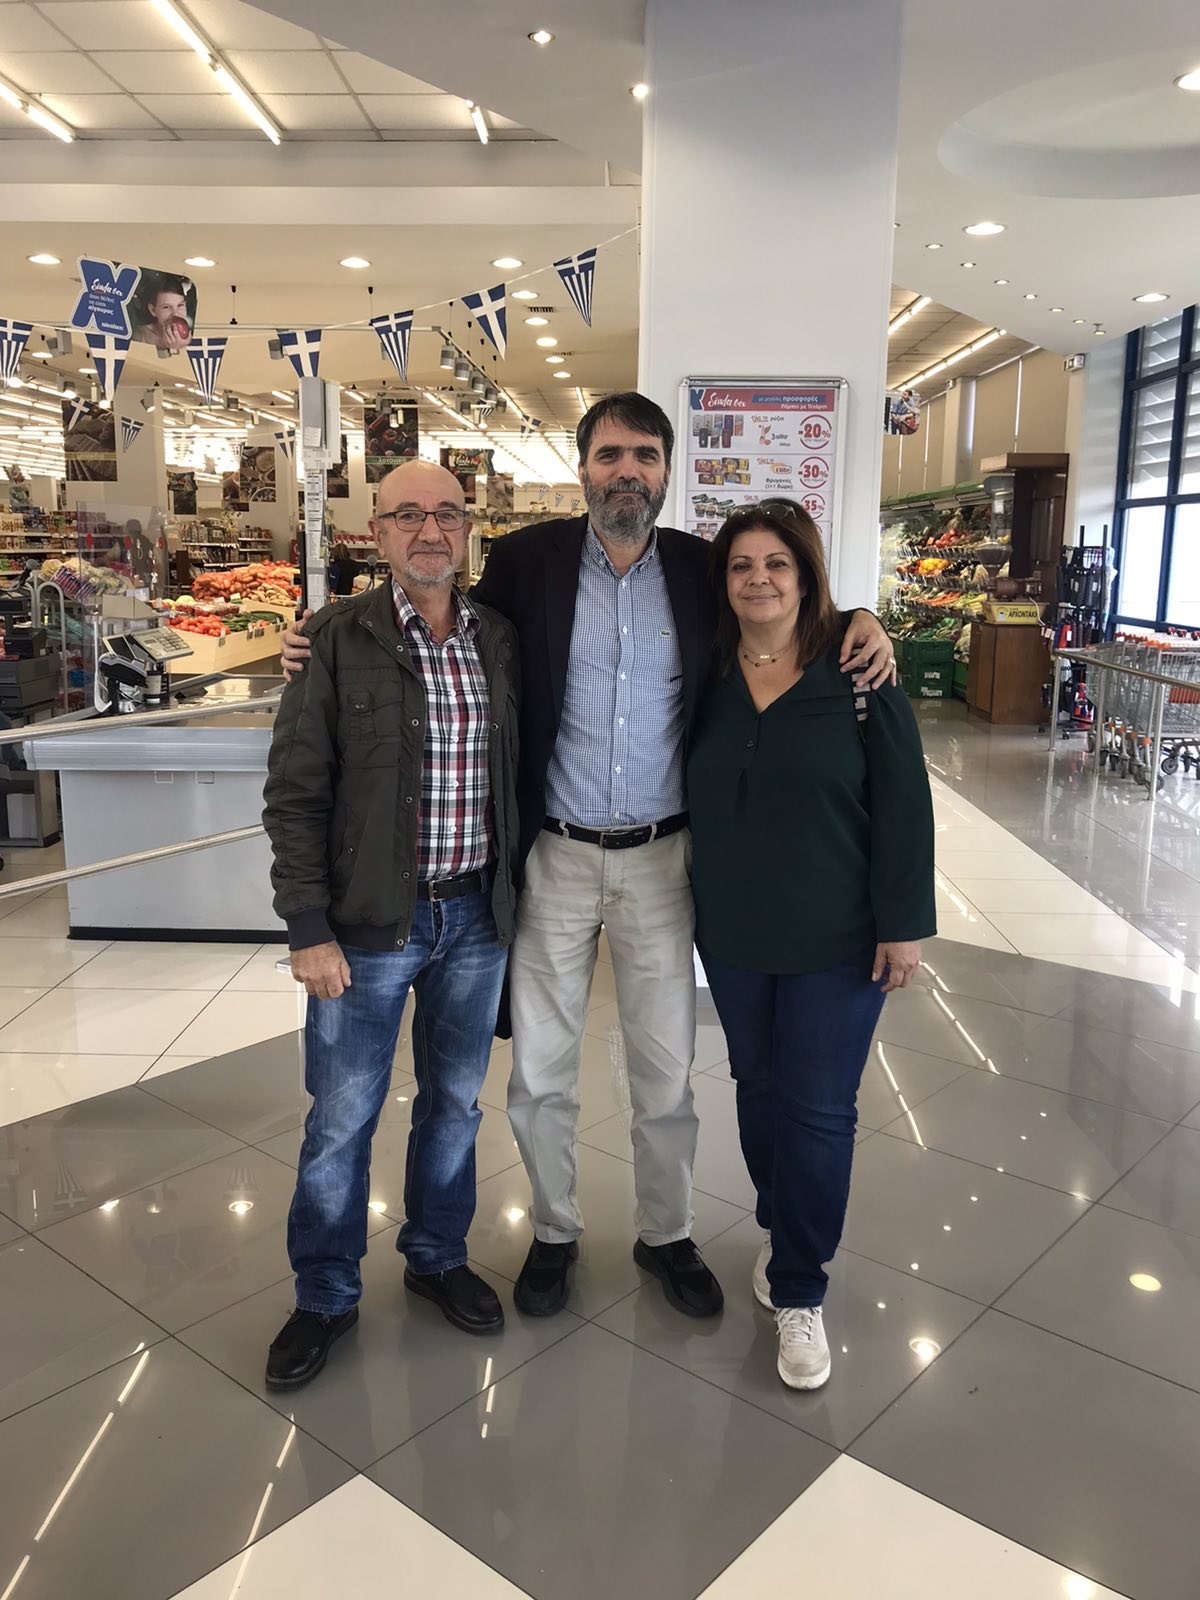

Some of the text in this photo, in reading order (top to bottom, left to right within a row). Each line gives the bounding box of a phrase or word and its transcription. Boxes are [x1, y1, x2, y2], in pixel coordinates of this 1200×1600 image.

[87, 305, 114, 315] σίγουρος
[782, 395, 818, 403] προσφορές
[798, 423, 831, 438] -20%
[798, 465, 829, 478] -30%
